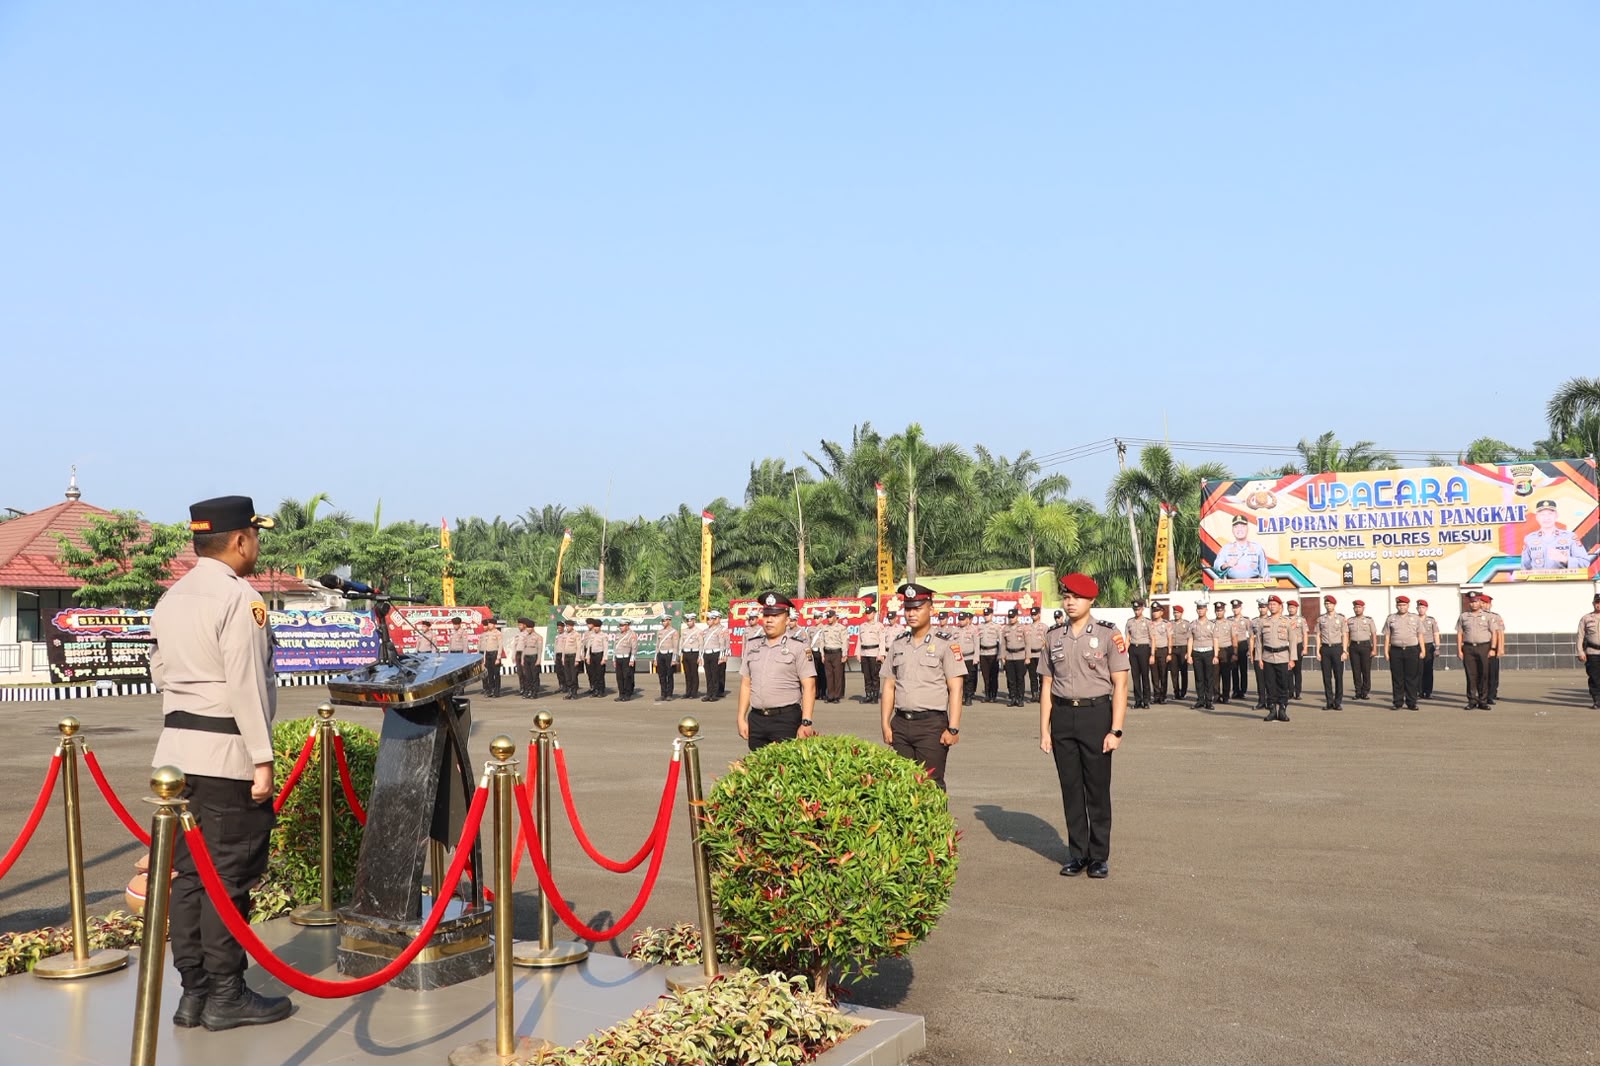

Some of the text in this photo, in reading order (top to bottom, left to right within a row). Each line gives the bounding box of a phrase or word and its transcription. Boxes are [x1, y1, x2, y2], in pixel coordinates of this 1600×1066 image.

[1308, 476, 1469, 510] UPACARA
[1257, 505, 1527, 533] LAPORAN KENAIKAN PANGKAT
[1290, 529, 1492, 549] PERSONEL POLRES MESUJI
[1336, 550, 1377, 560] PERIODE
[1382, 549, 1393, 559] 01
[1395, 549, 1415, 558] JULI
[79, 617, 135, 625] SELAMAT
[64, 648, 106, 657] BRIPTU
[65, 655, 108, 664] BRIPTU
[96, 666, 149, 677] SUMBER
